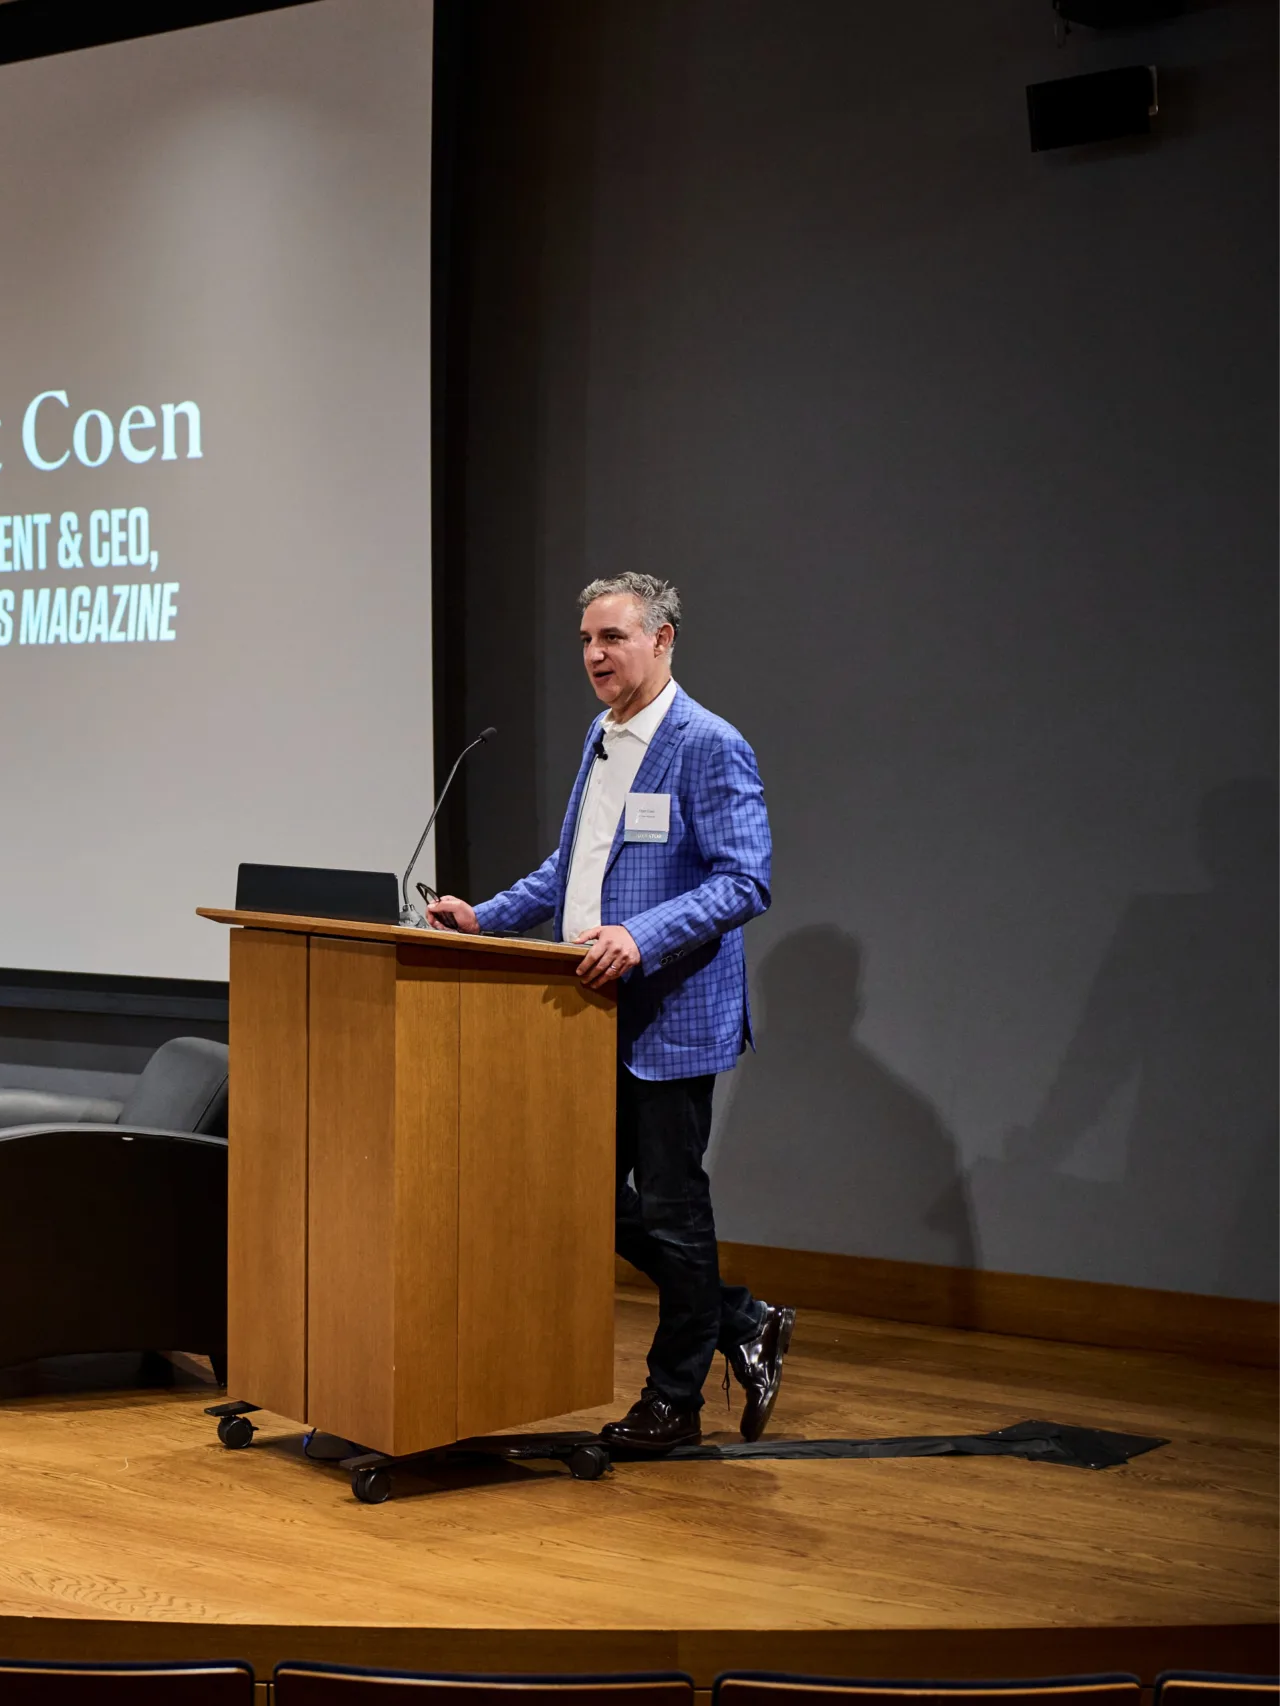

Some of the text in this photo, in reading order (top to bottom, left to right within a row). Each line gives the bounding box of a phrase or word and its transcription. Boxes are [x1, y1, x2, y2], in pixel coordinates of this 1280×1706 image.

[22, 390, 204, 471] Coen
[57, 511, 84, 570] &
[89, 506, 159, 572] CEO,
[19, 582, 180, 645] MAGAZINE
